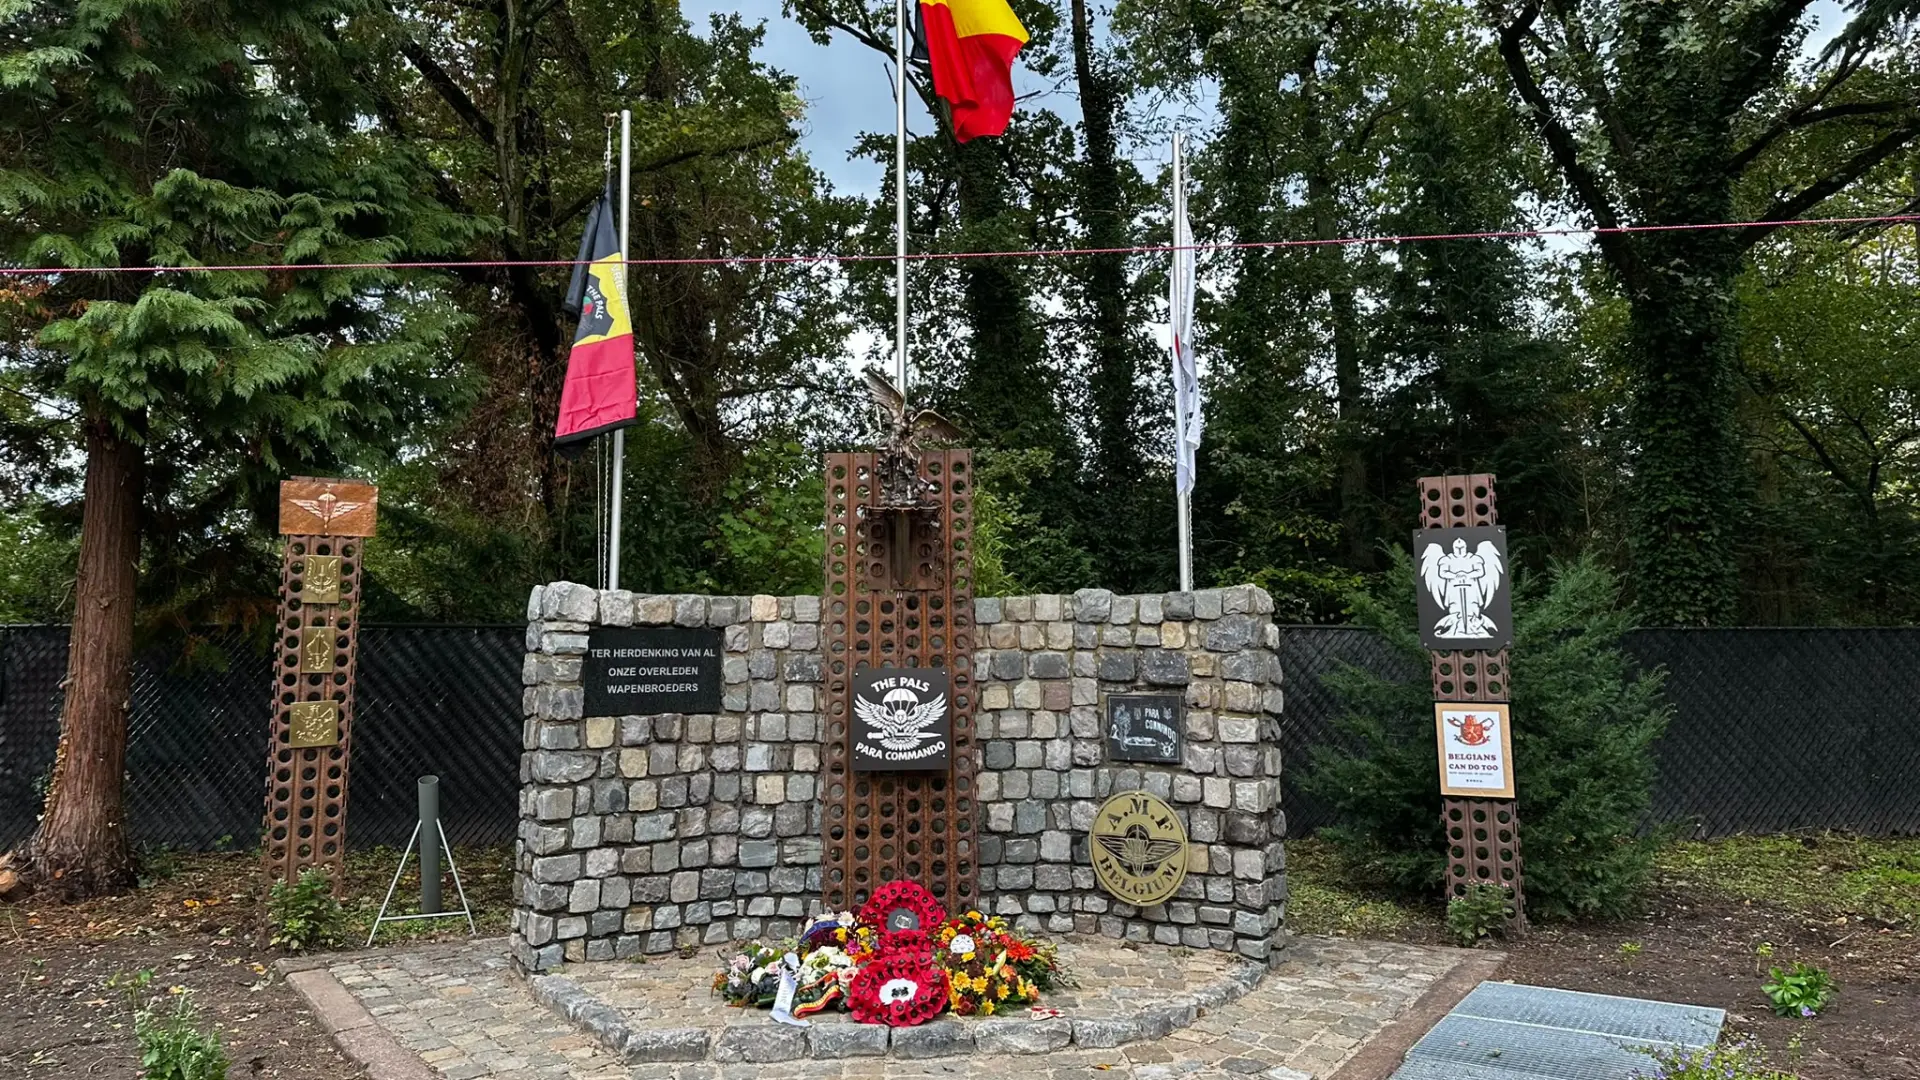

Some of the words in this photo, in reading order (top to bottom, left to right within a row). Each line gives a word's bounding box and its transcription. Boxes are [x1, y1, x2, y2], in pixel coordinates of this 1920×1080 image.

[586, 285, 601, 301] THE
[595, 300, 604, 319] PALS
[591, 649, 610, 658] TER
[613, 648, 679, 658] HERDENKING
[681, 648, 701, 657] VAN
[703, 648, 716, 657] AL
[608, 667, 636, 676] ONZE
[638, 666, 699, 676] OVERLEDEN
[607, 683, 699, 694] WAPENBROEDERS
[870, 677, 897, 692] THE
[899, 676, 930, 692] PALS
[1144, 707, 1160, 720] PARA
[855, 741, 882, 759] PARA
[885, 740, 946, 761] COMMANDO
[1448, 753, 1497, 761] BELGIANS
[1099, 856, 1178, 895] BELGIUM
